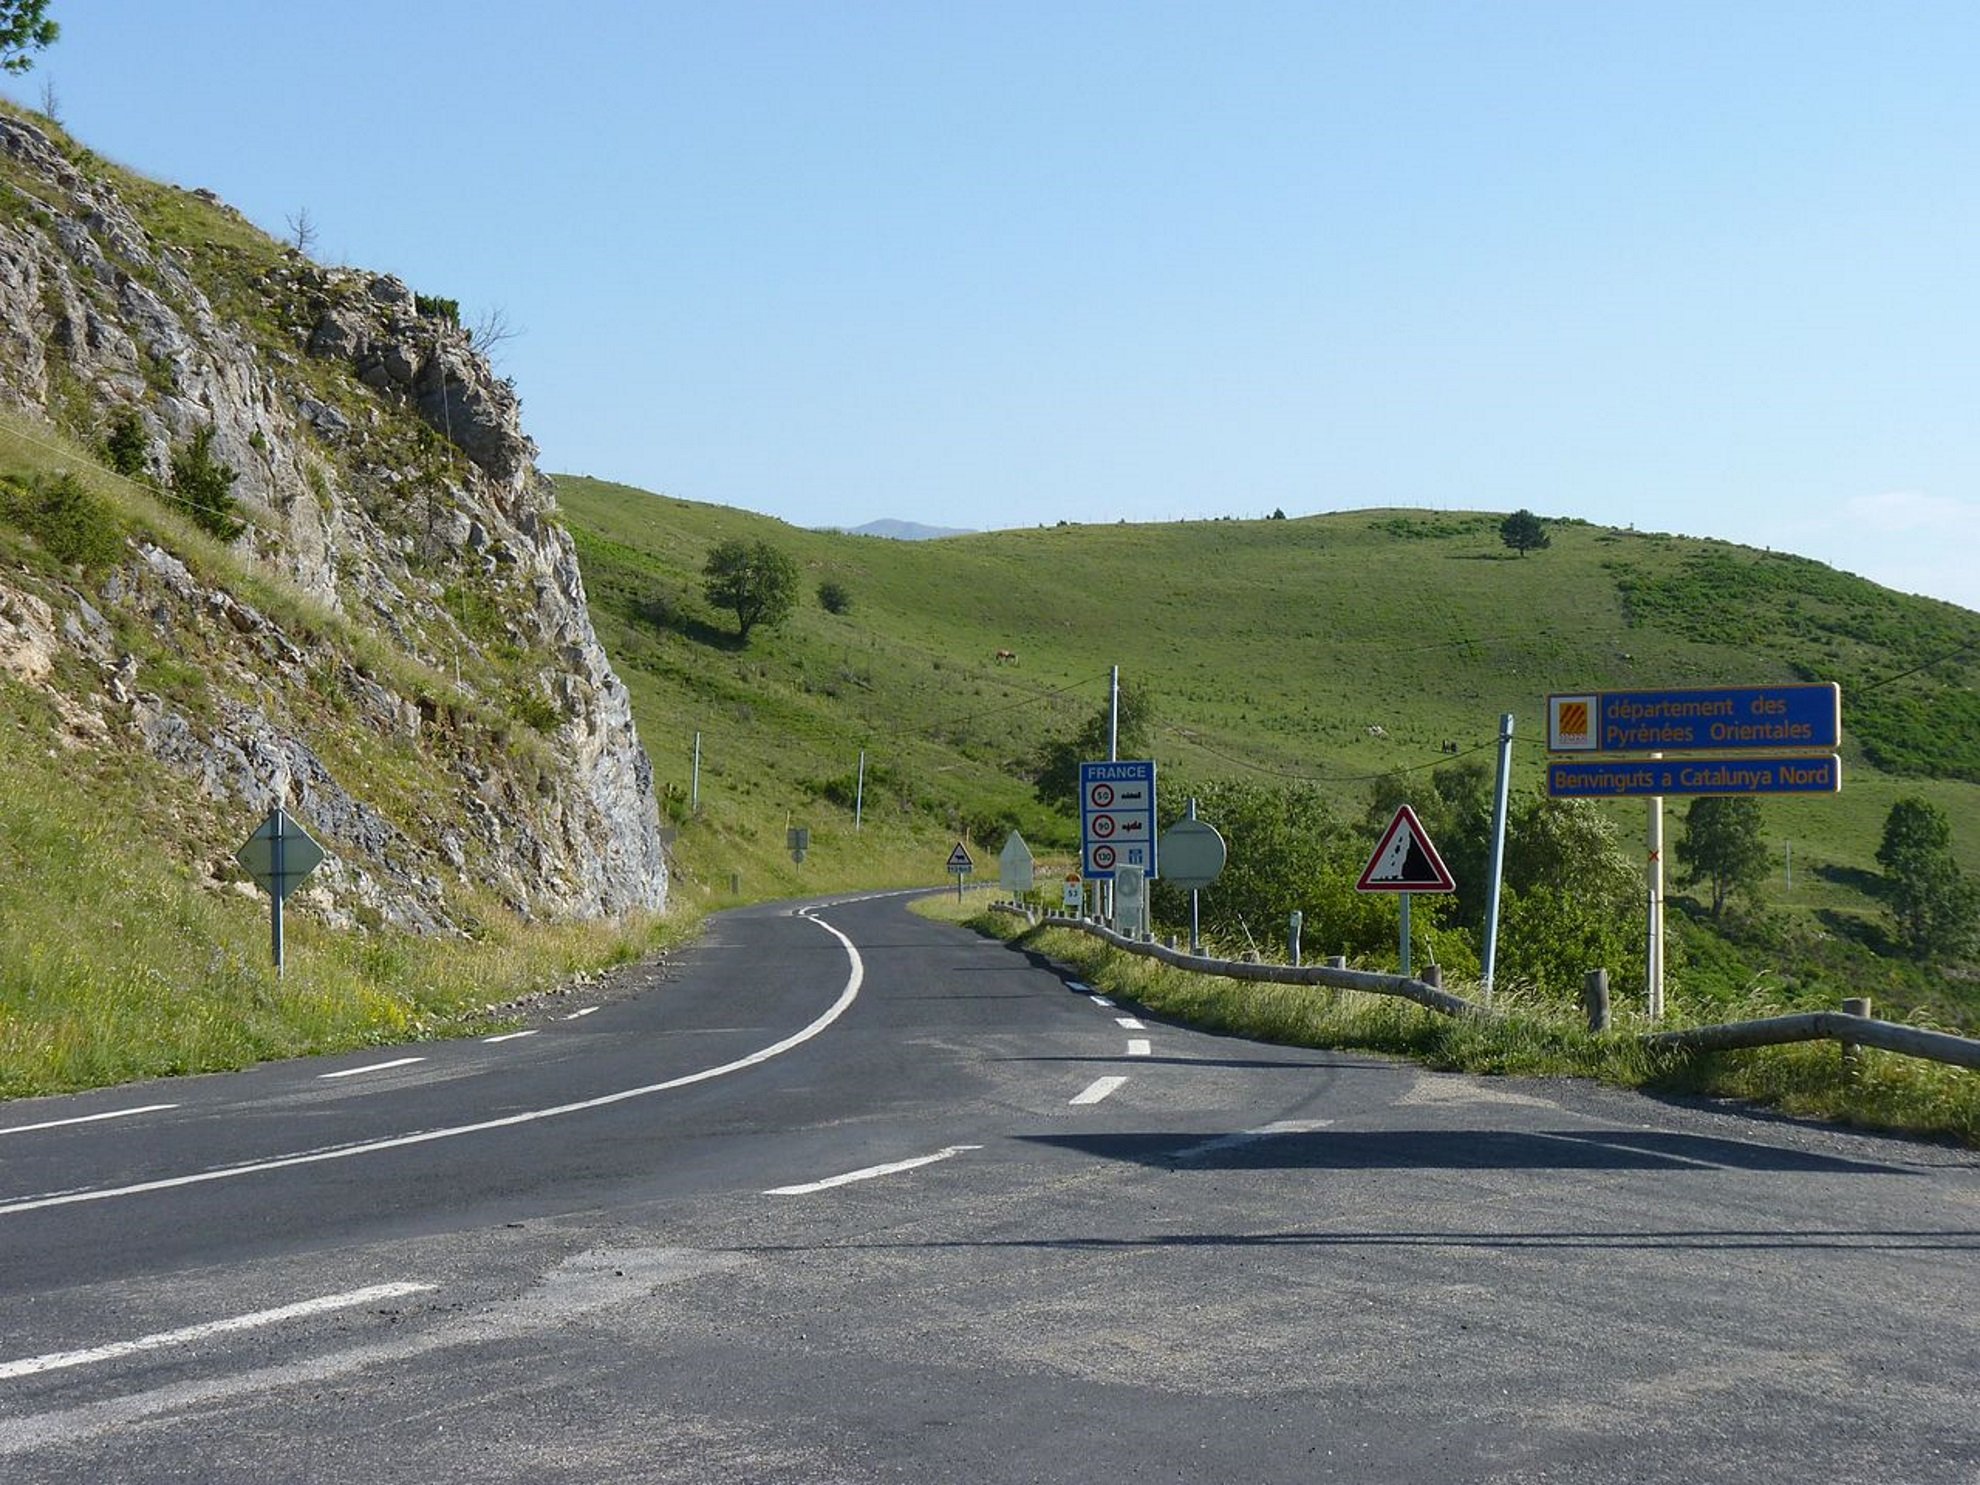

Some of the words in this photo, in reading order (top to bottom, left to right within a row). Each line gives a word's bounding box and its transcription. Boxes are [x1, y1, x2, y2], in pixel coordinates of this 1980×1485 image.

[1607, 697, 1734, 722] département
[1751, 695, 1787, 714] des
[1710, 720, 1812, 740] Orientales
[1088, 766, 1146, 779] FRANCE
[1555, 769, 1653, 792] Benvinguts
[1662, 773, 1672, 786] a
[1680, 766, 1771, 788] Catalunya
[1779, 766, 1829, 784] Nord
[1097, 791, 1109, 799] 50
[1098, 822, 1109, 831] 90
